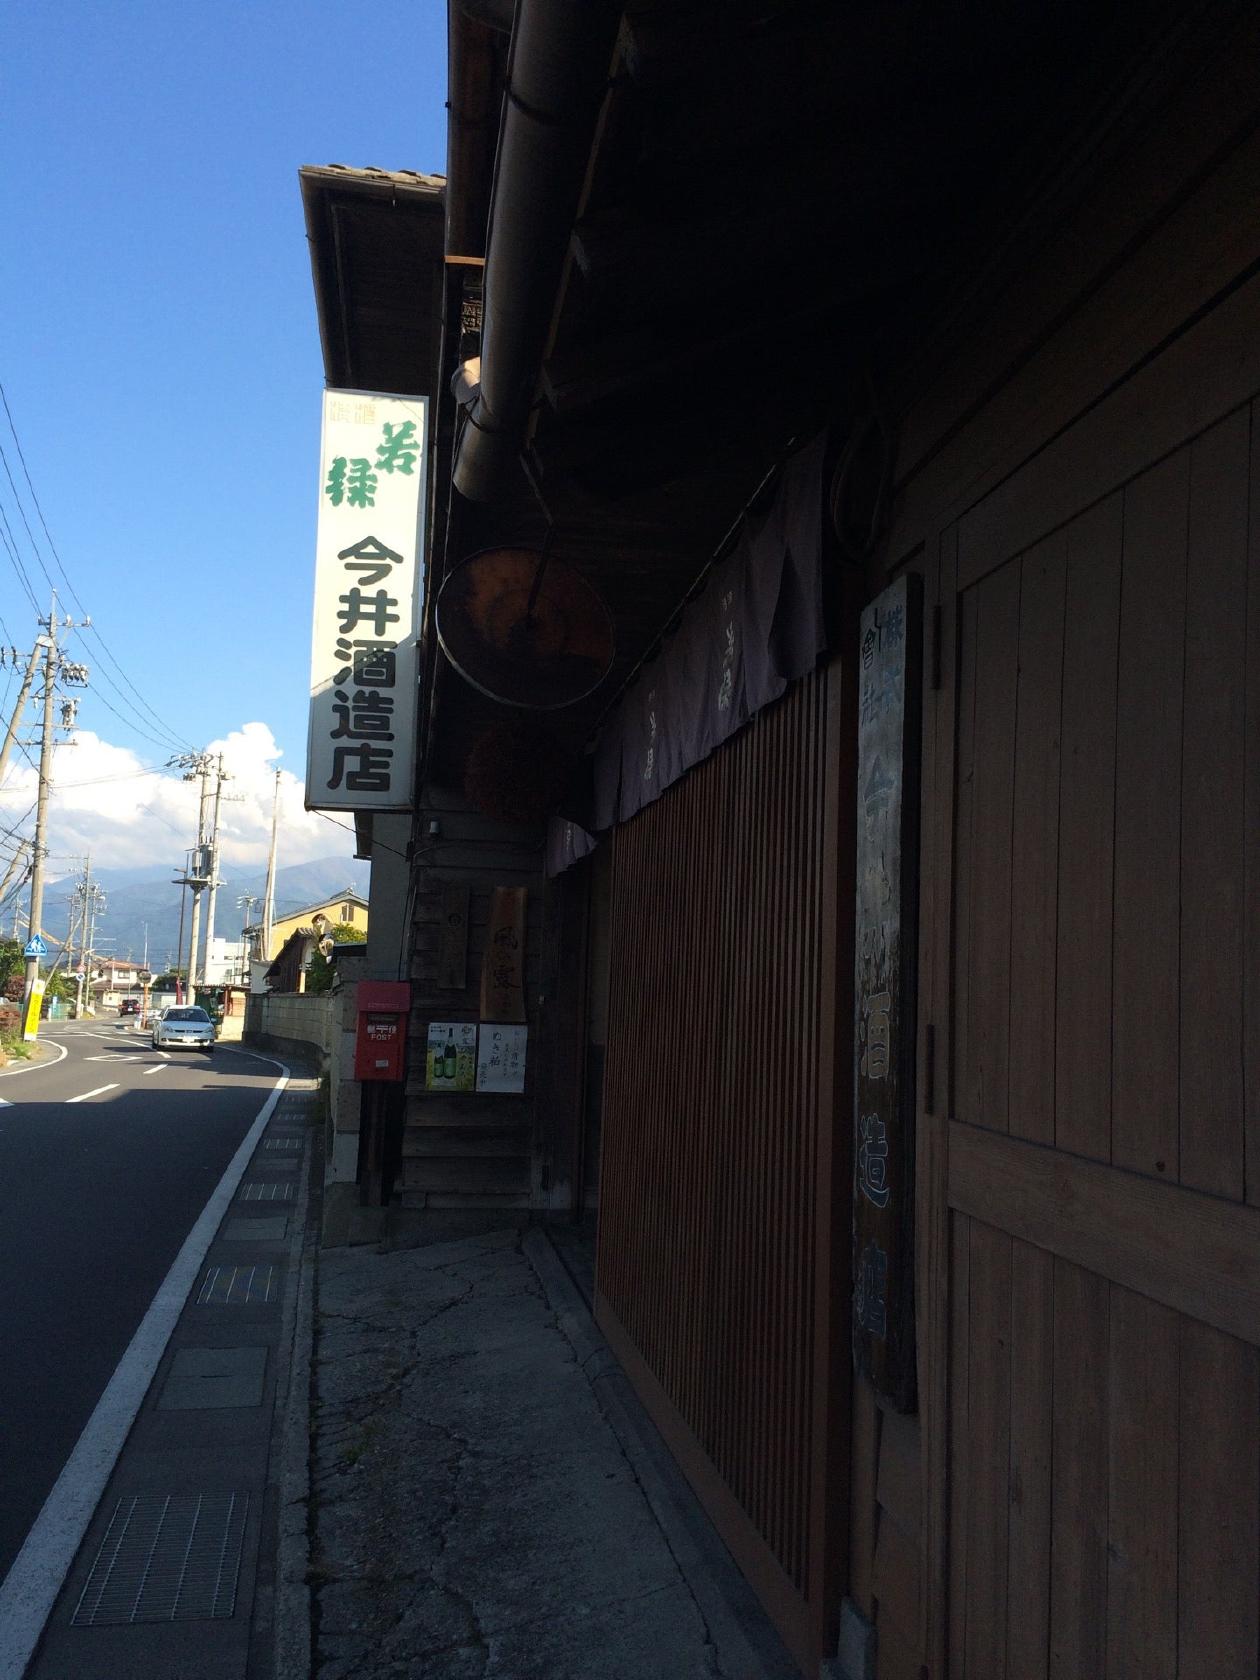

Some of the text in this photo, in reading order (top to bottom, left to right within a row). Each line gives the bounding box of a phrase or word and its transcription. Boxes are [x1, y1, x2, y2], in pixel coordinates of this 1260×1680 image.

[327, 535, 404, 792] 今井酒造店
